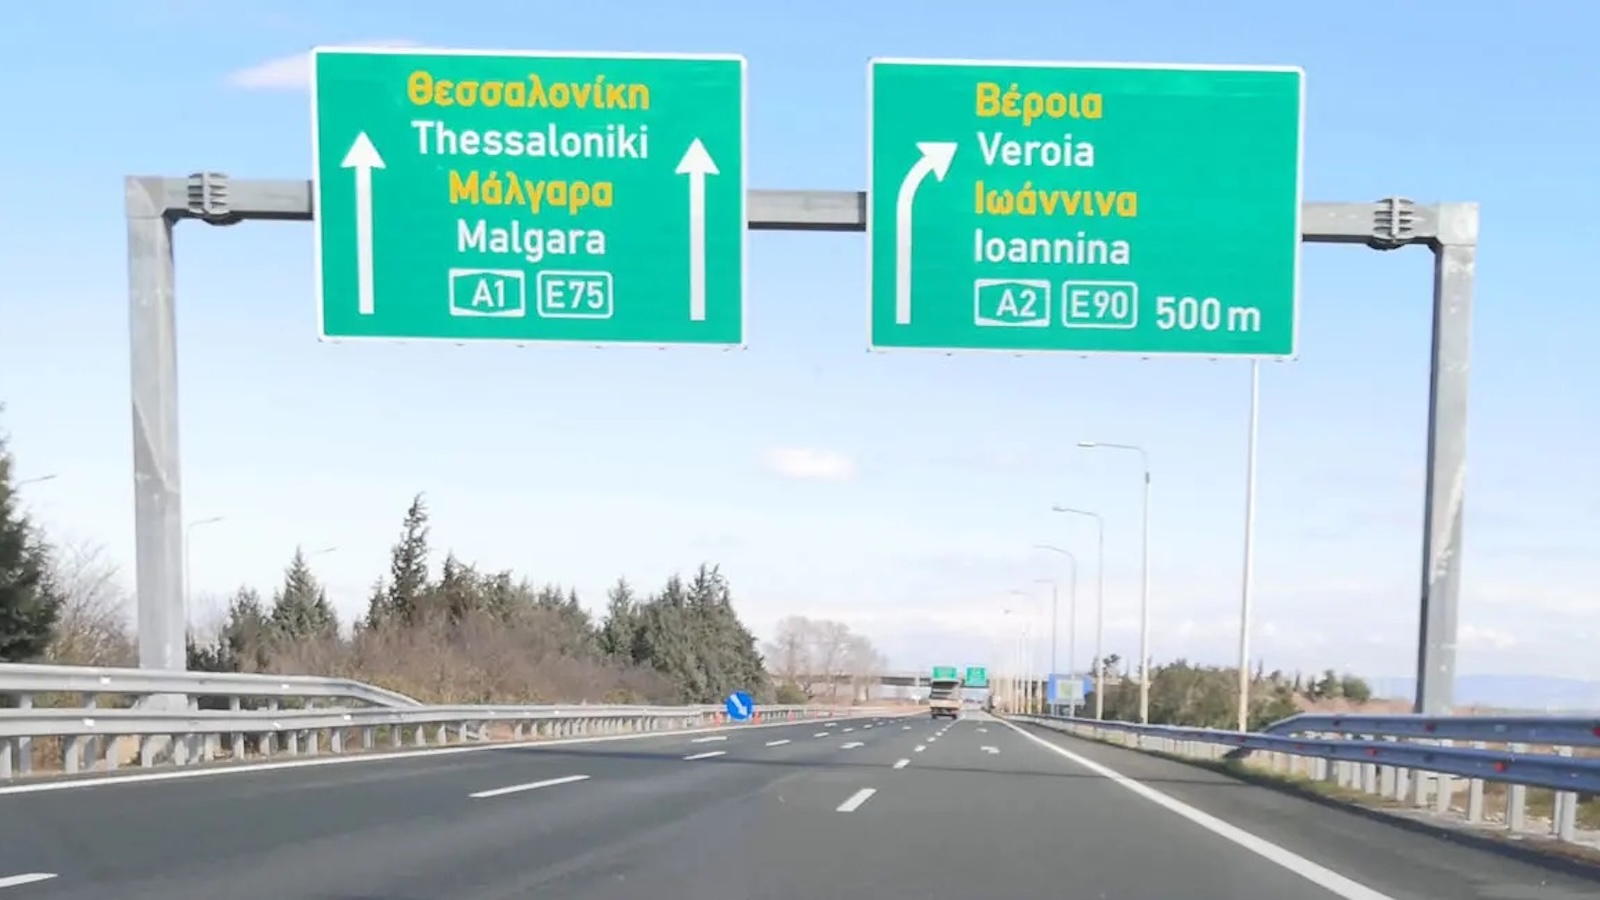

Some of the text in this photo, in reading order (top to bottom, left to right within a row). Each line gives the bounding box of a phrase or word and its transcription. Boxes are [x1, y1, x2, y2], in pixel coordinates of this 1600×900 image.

[408, 70, 650, 110] Θεσσαλονίκη
[976, 82, 1104, 126] Βέροια
[411, 120, 649, 159] Thessaloniki
[976, 132, 1095, 167] Veroia
[449, 170, 613, 215] Μάλγαρα
[974, 180, 1138, 217] Ιωάννινα
[457, 219, 606, 262] Malgara
[974, 228, 1131, 265] Ioannina
[471, 279, 506, 307] A1
[995, 290, 1037, 319] A2
[1156, 297, 1221, 332] 500
[1228, 306, 1261, 332] m
